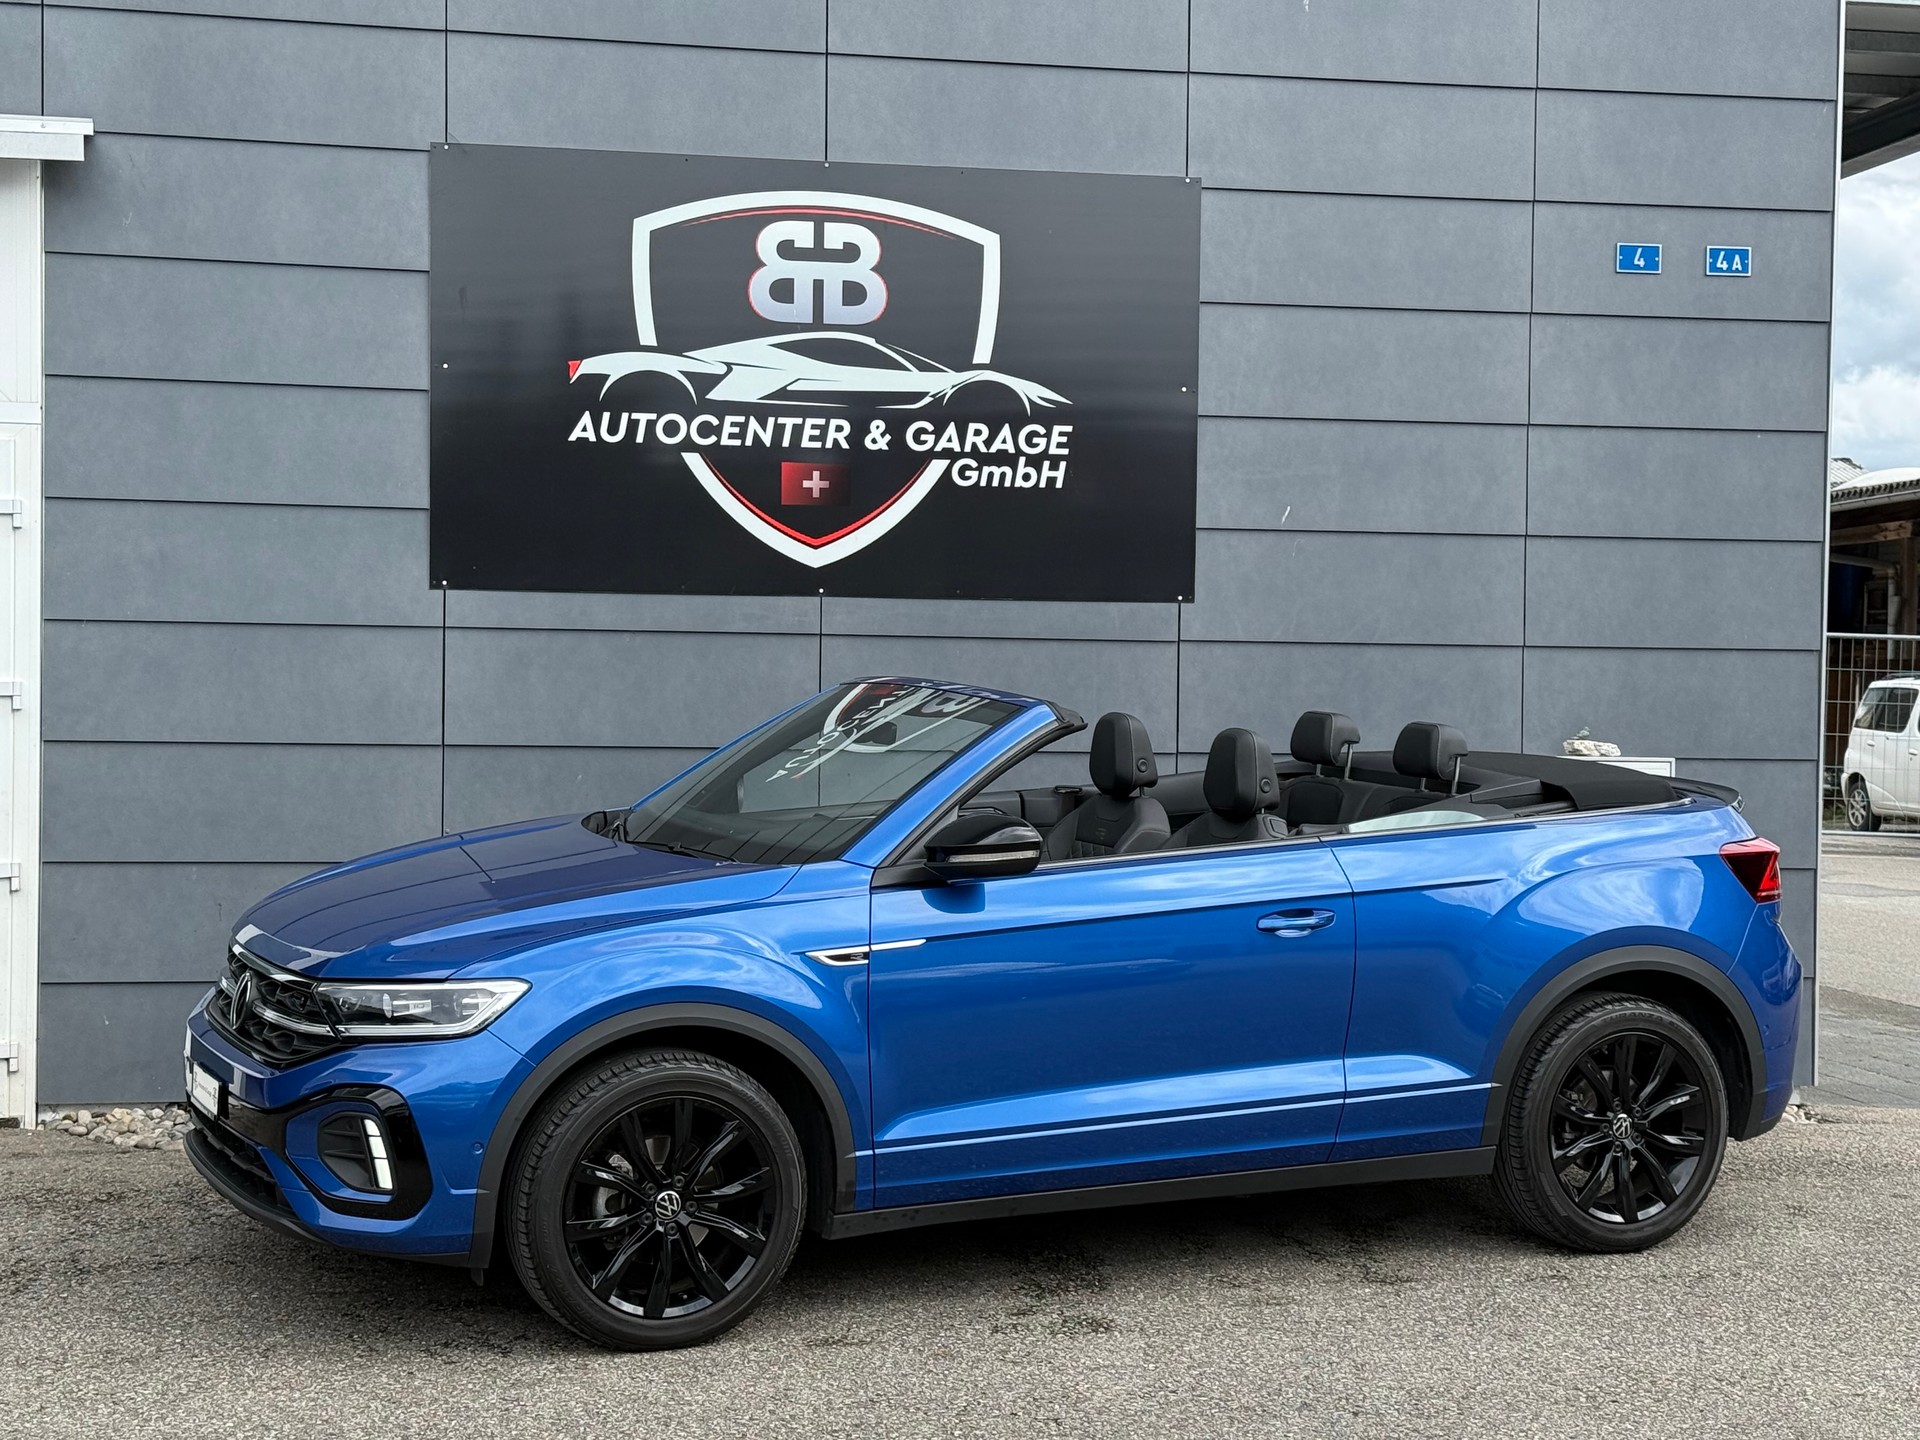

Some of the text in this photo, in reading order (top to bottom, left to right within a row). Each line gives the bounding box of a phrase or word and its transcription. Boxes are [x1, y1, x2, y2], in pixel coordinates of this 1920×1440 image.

[1633, 248, 1645, 268] 4
[568, 410, 1073, 455] AUTOCENTER & GARAGE
[951, 458, 1067, 489] GmbH
